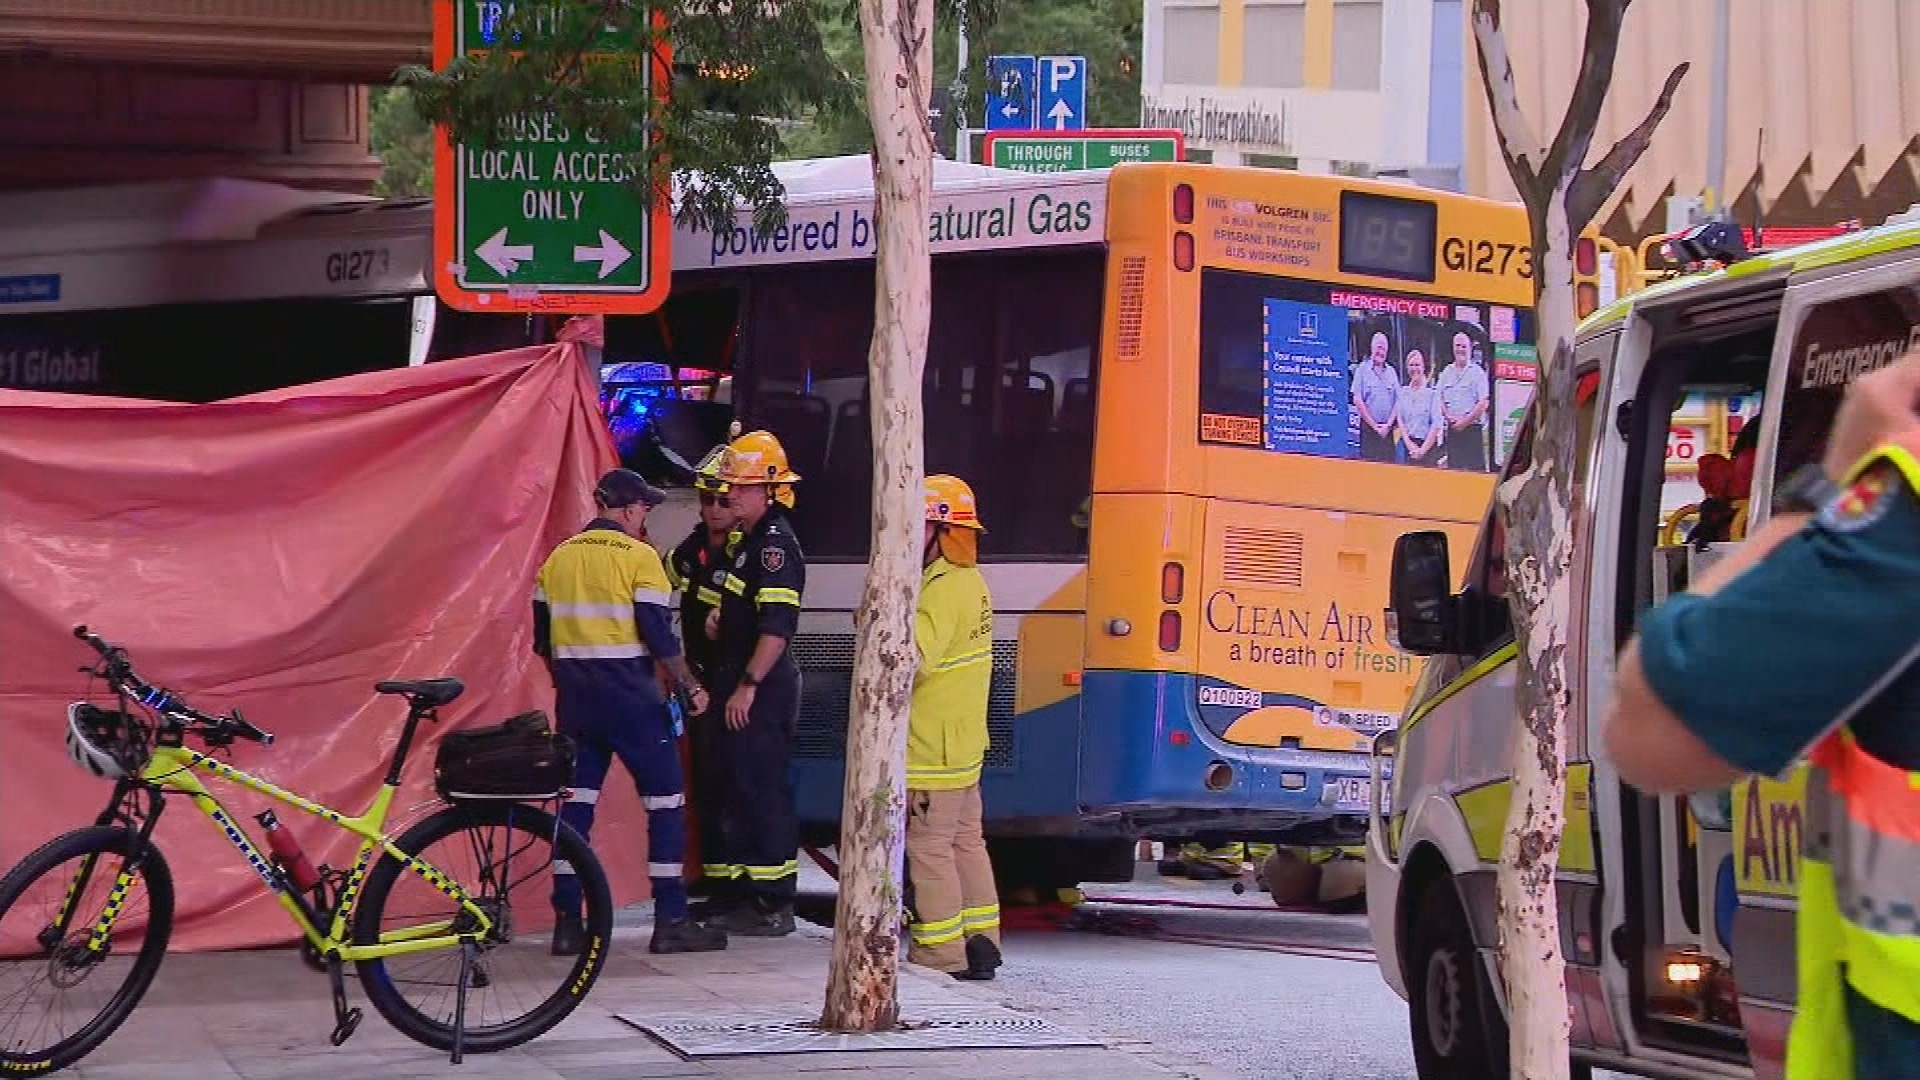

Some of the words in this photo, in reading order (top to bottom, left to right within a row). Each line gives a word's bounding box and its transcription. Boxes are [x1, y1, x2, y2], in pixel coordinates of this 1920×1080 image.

[1051, 58, 1077, 92] P
[469, 152, 540, 181] LOCAL
[552, 152, 637, 181] ACCESS
[1007, 145, 1072, 160] THROUGH
[1110, 145, 1150, 157] BUSES
[523, 190, 584, 220] ONLY
[929, 197, 1014, 243] atural
[1028, 193, 1092, 234] Gas
[1255, 203, 1309, 220] VOLGREN
[711, 211, 839, 265] powered
[1443, 237, 1533, 279] GI273
[1330, 293, 1417, 317] EMERGENCY
[1418, 301, 1447, 319] EXIT
[24, 348, 99, 384] Global
[1207, 590, 1310, 639] CLEAN
[1320, 602, 1374, 646] AIR
[1230, 643, 1241, 661] a
[1250, 640, 1317, 667] breath
[1326, 648, 1345, 669] of
[1354, 646, 1412, 674] fresh
